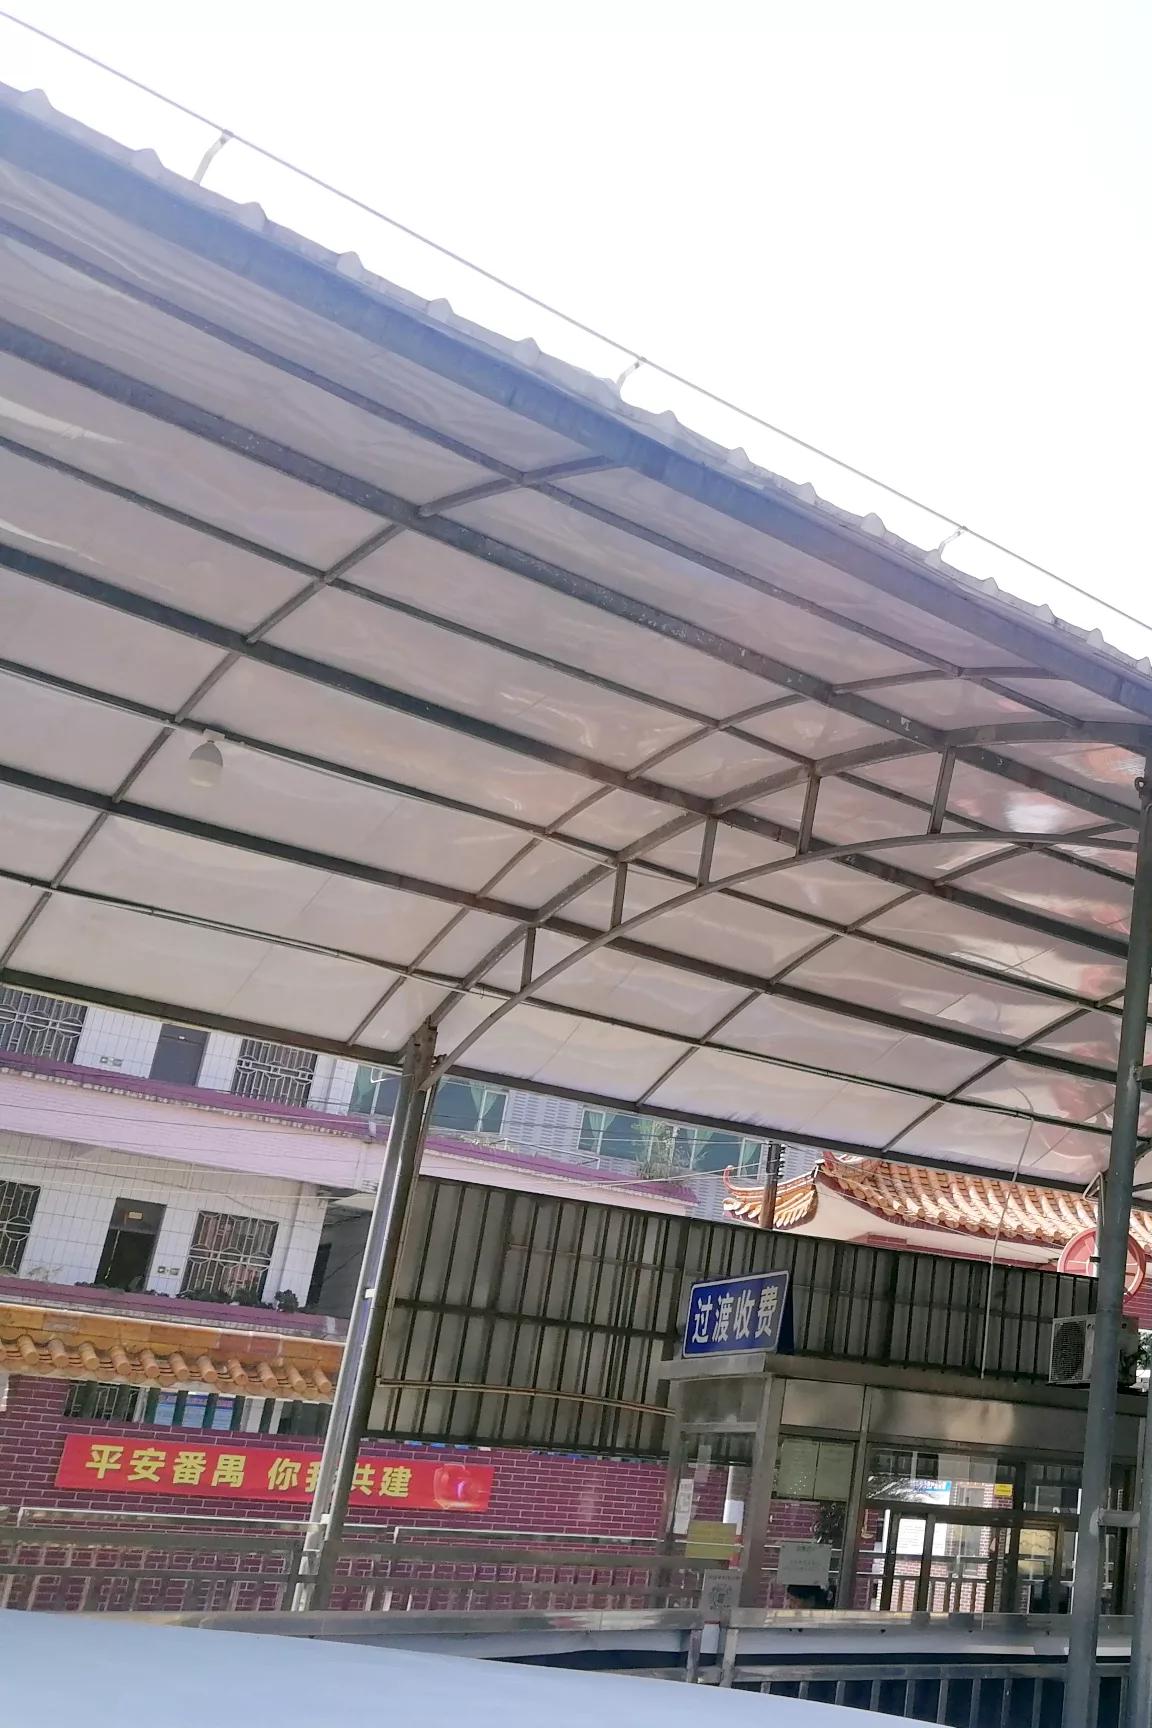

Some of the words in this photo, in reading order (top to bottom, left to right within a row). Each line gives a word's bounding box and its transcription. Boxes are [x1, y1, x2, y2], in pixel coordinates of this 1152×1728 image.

[692, 1285, 779, 1343] 过渡收费
[85, 1443, 248, 1489] 平安番禺
